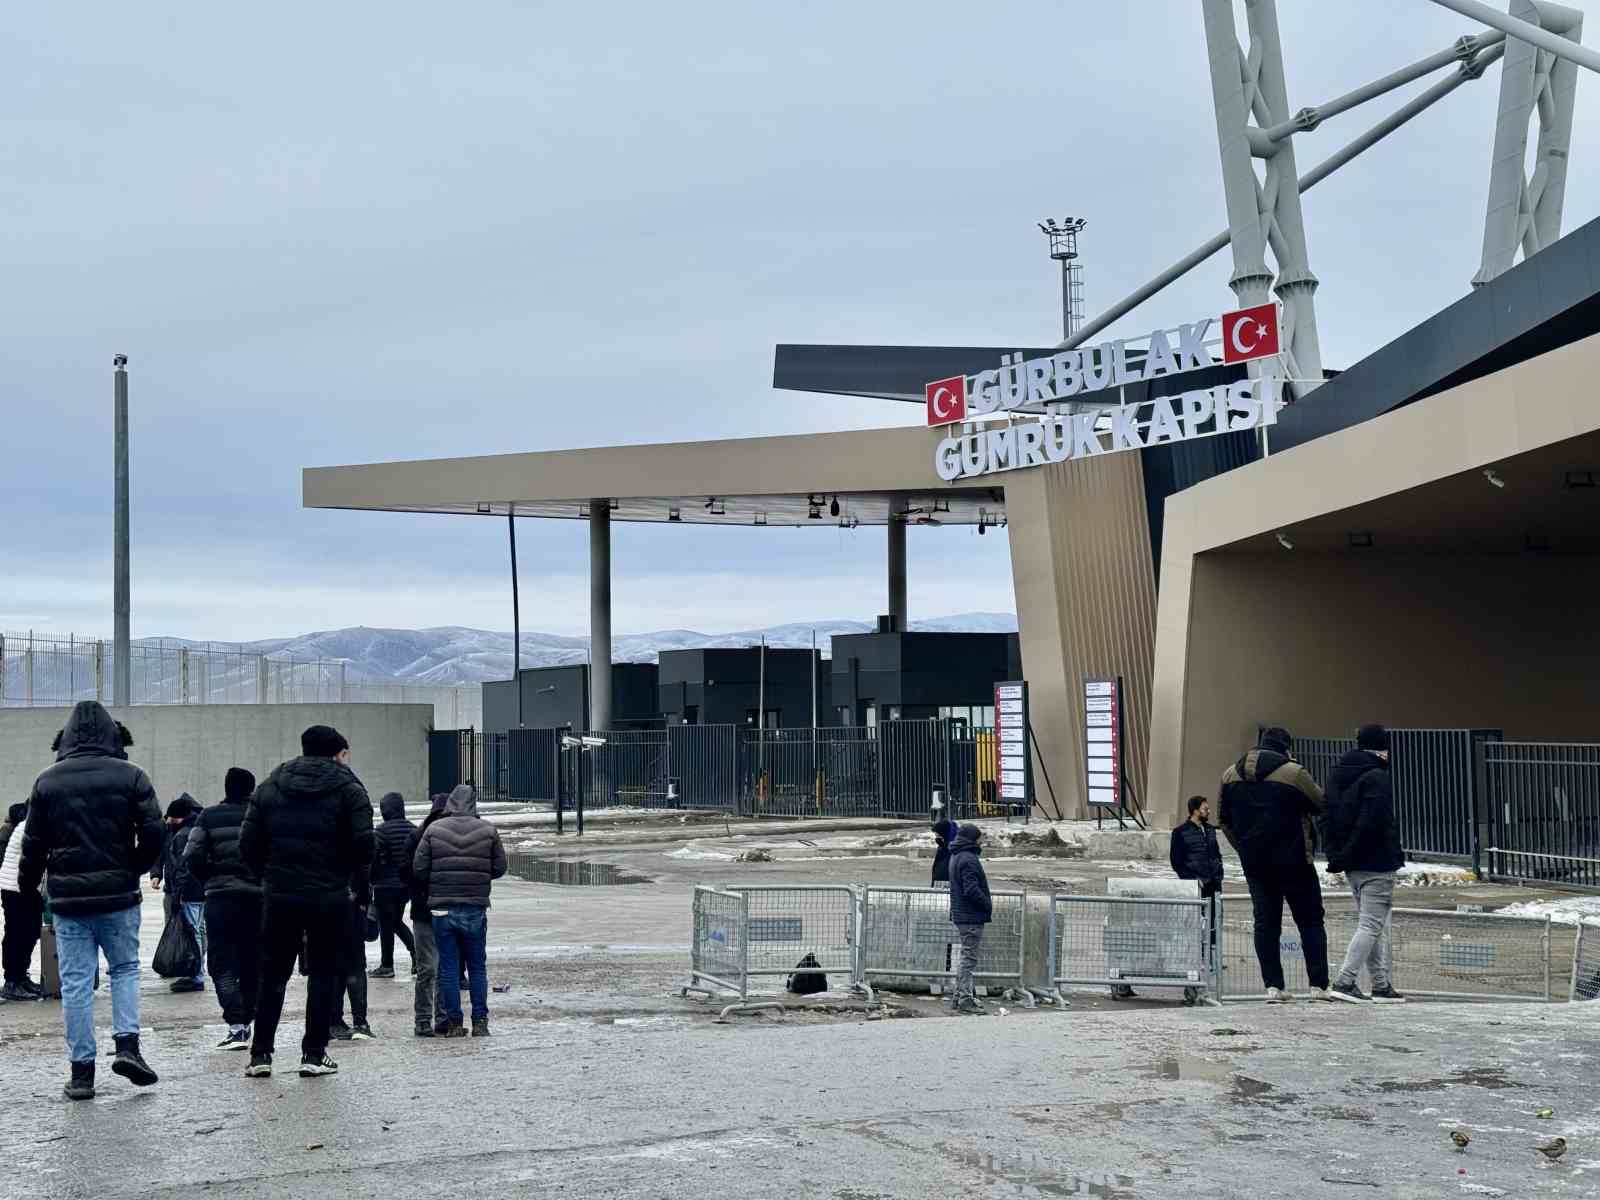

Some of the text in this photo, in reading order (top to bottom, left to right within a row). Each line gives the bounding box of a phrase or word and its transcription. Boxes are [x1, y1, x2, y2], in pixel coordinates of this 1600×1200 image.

[971, 320, 1214, 411] GÜRBULAK
[935, 372, 1276, 480] GÜMRÜK KAPISI
